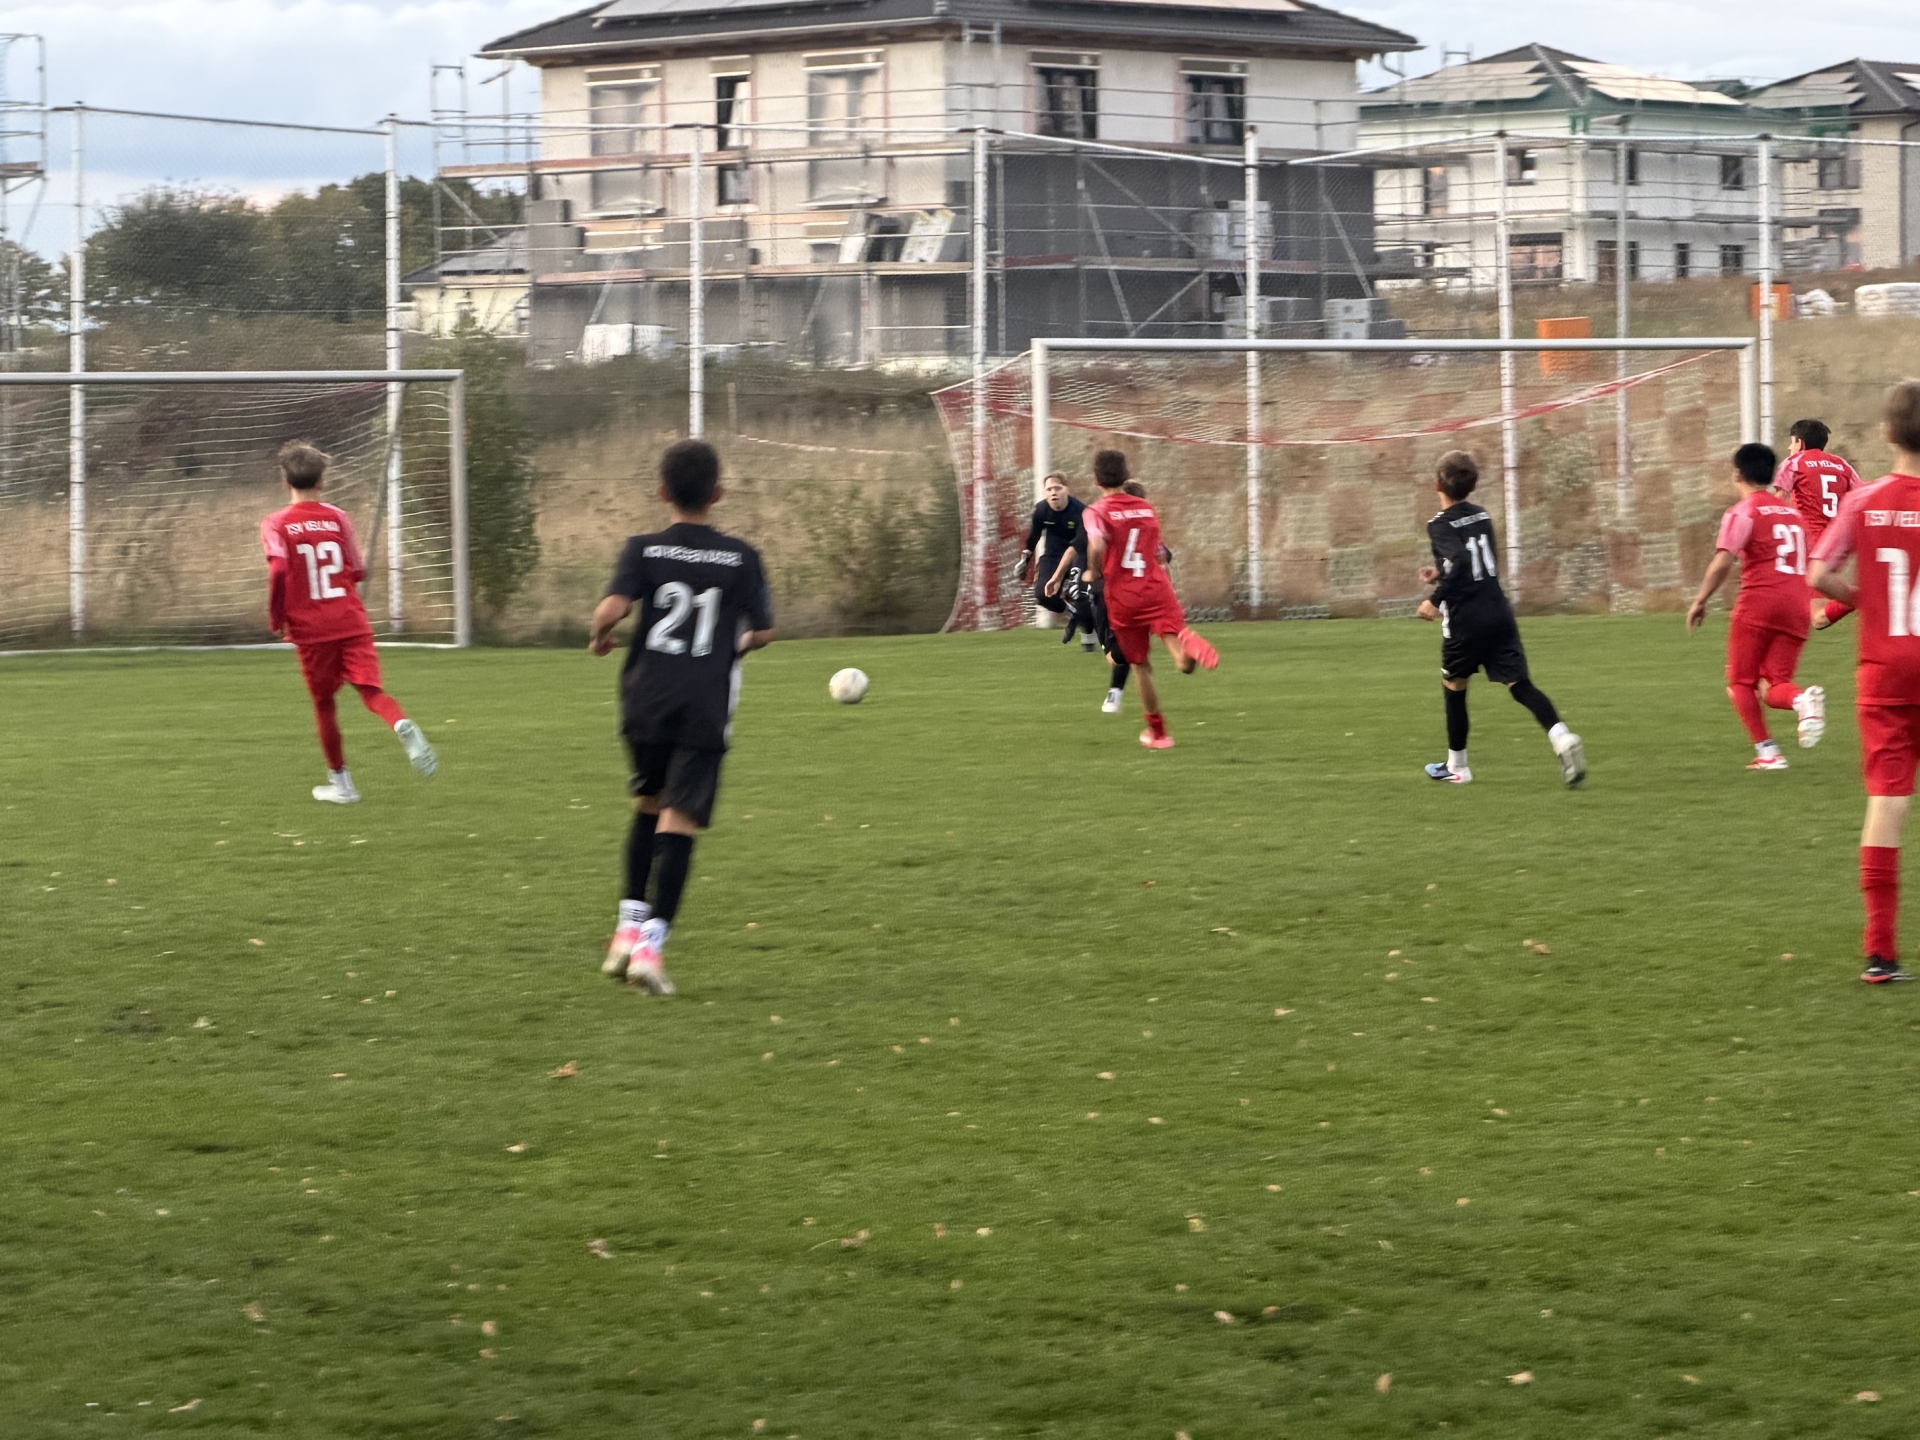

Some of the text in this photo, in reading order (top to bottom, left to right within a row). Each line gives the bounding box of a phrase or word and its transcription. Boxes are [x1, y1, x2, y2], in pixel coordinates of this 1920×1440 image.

[1820, 474, 1838, 518] 5
[296, 541, 347, 600] 12
[1121, 528, 1147, 578] 4
[1465, 533, 1497, 582] 11
[1772, 523, 1807, 576] 21
[1875, 547, 1920, 637] 1
[645, 581, 723, 658] 21
